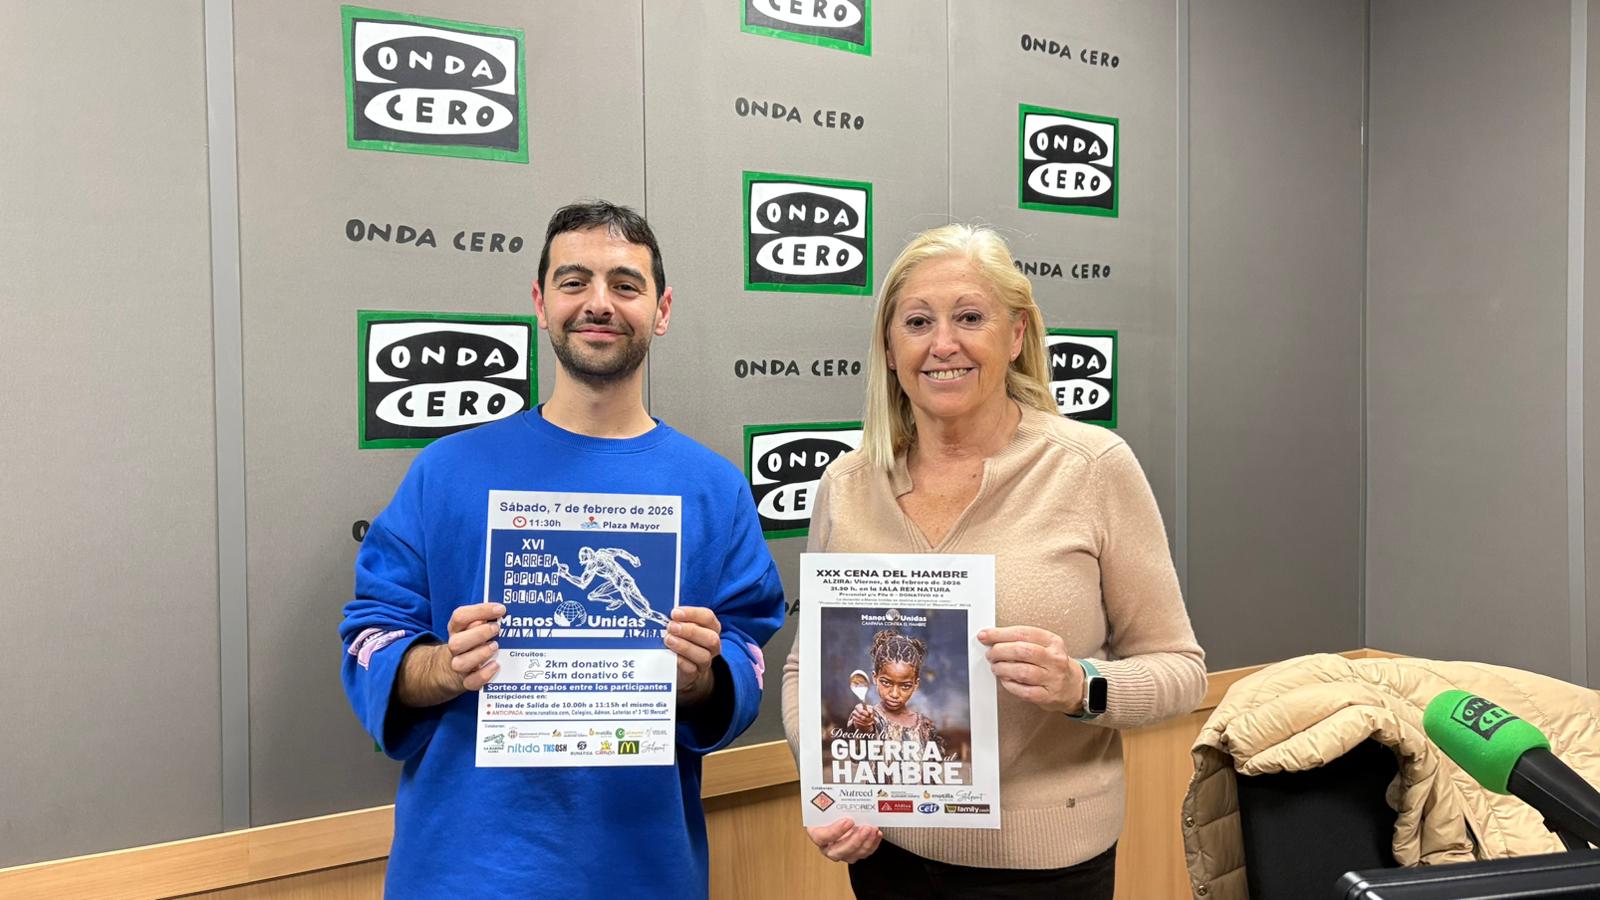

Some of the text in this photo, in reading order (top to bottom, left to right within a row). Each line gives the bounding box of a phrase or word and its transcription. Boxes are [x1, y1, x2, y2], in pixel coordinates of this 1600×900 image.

[1020, 33, 1120, 68] ONDA CERO
[377, 45, 494, 80] ONDA
[386, 94, 495, 128] CERO
[735, 97, 866, 131] ONDA CERO
[1036, 131, 1102, 157] ONDA
[1040, 168, 1101, 192] CERO
[766, 202, 850, 228] ONDA
[345, 217, 524, 255] ONDA CERO
[772, 242, 850, 268] CERO
[1071, 263, 1111, 279] CERO
[390, 345, 506, 369] ONDA
[1052, 352, 1100, 370] NDA
[735, 358, 862, 379] ONDA CERO
[398, 391, 506, 419] CERO
[1055, 387, 1099, 406] ERO
[499, 501, 674, 516] Sábado, 7 de febrero de 2026
[773, 488, 808, 512] CE
[529, 518, 561, 528] 11:30h
[602, 521, 661, 532] Plaza Mayor
[521, 538, 545, 550] XVI
[504, 552, 559, 567] CARRERA
[504, 572, 559, 586] POPULAR
[816, 569, 968, 579] XXX CENA DEL HAMBRE
[498, 614, 646, 628] Manos Unidas
[545, 660, 636, 669] 2km donativo 3€
[544, 671, 635, 680] 5km donativo 6€
[487, 683, 668, 693] Sorteo de regalos entre los participantes
[830, 727, 876, 739] Declara
[831, 739, 958, 762] GUERRA al
[832, 760, 963, 785] HAMBRE
